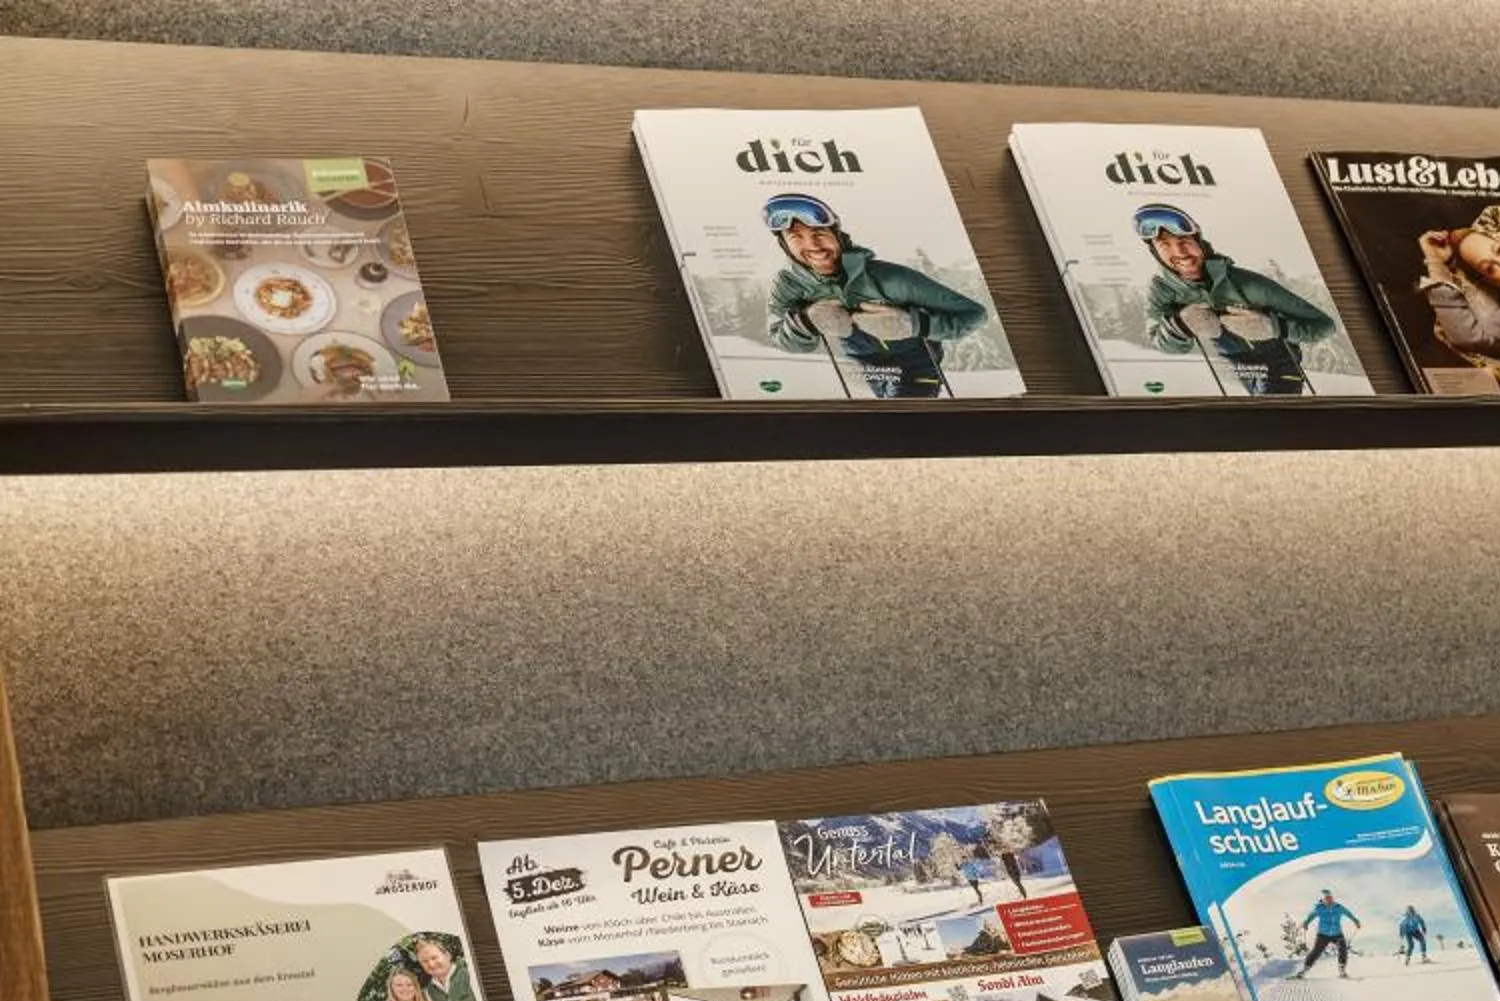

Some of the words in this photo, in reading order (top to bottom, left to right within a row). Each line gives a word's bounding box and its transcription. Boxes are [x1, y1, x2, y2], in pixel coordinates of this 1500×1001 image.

[735, 138, 864, 174] dich
[1105, 151, 1217, 186] dich
[185, 215, 203, 226] by
[210, 213, 274, 226] Richard
[277, 213, 326, 225] Rauch
[1194, 791, 1328, 830] Langlauf-
[1209, 827, 1299, 855] schule
[612, 845, 763, 883] Perner
[631, 885, 687, 906] Wein
[691, 884, 705, 899] &
[709, 881, 760, 898] Käse
[138, 919, 312, 948] HANDWERKSKÄSEREI
[142, 943, 238, 964] MOSERHOF
[1140, 956, 1215, 976] Langlaufen
